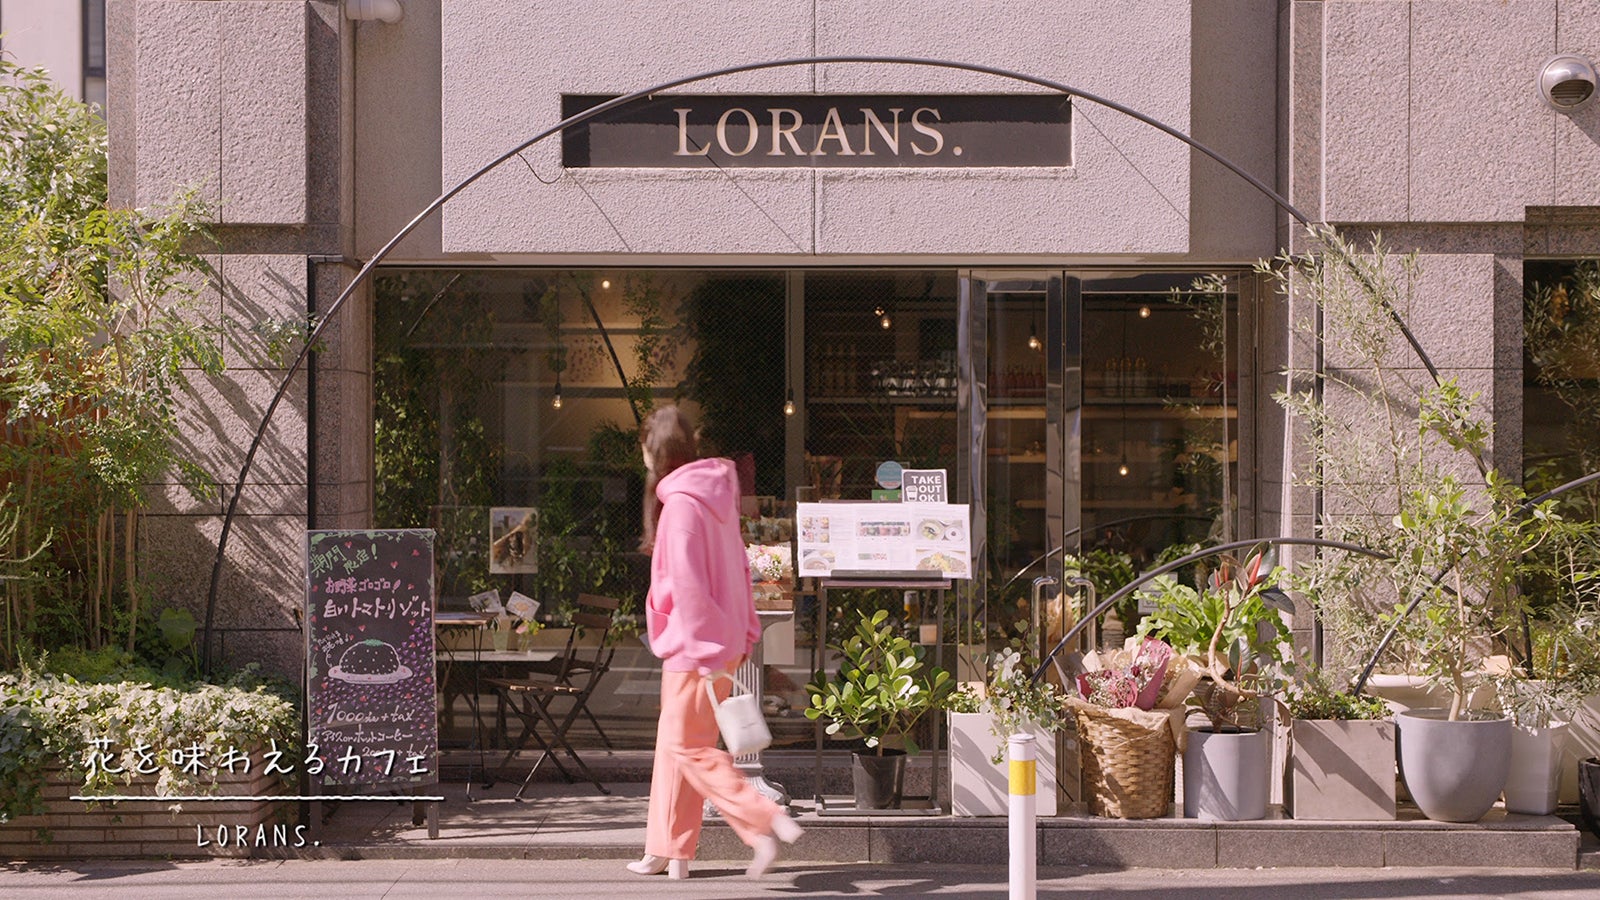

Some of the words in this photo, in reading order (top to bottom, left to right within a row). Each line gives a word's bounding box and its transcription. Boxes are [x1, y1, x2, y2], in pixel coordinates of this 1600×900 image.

[673, 107, 965, 157] LORANS.
[911, 476, 941, 484] TAKE
[919, 485, 942, 493] OUT
[323, 596, 431, 619] 白いトマトリゾット
